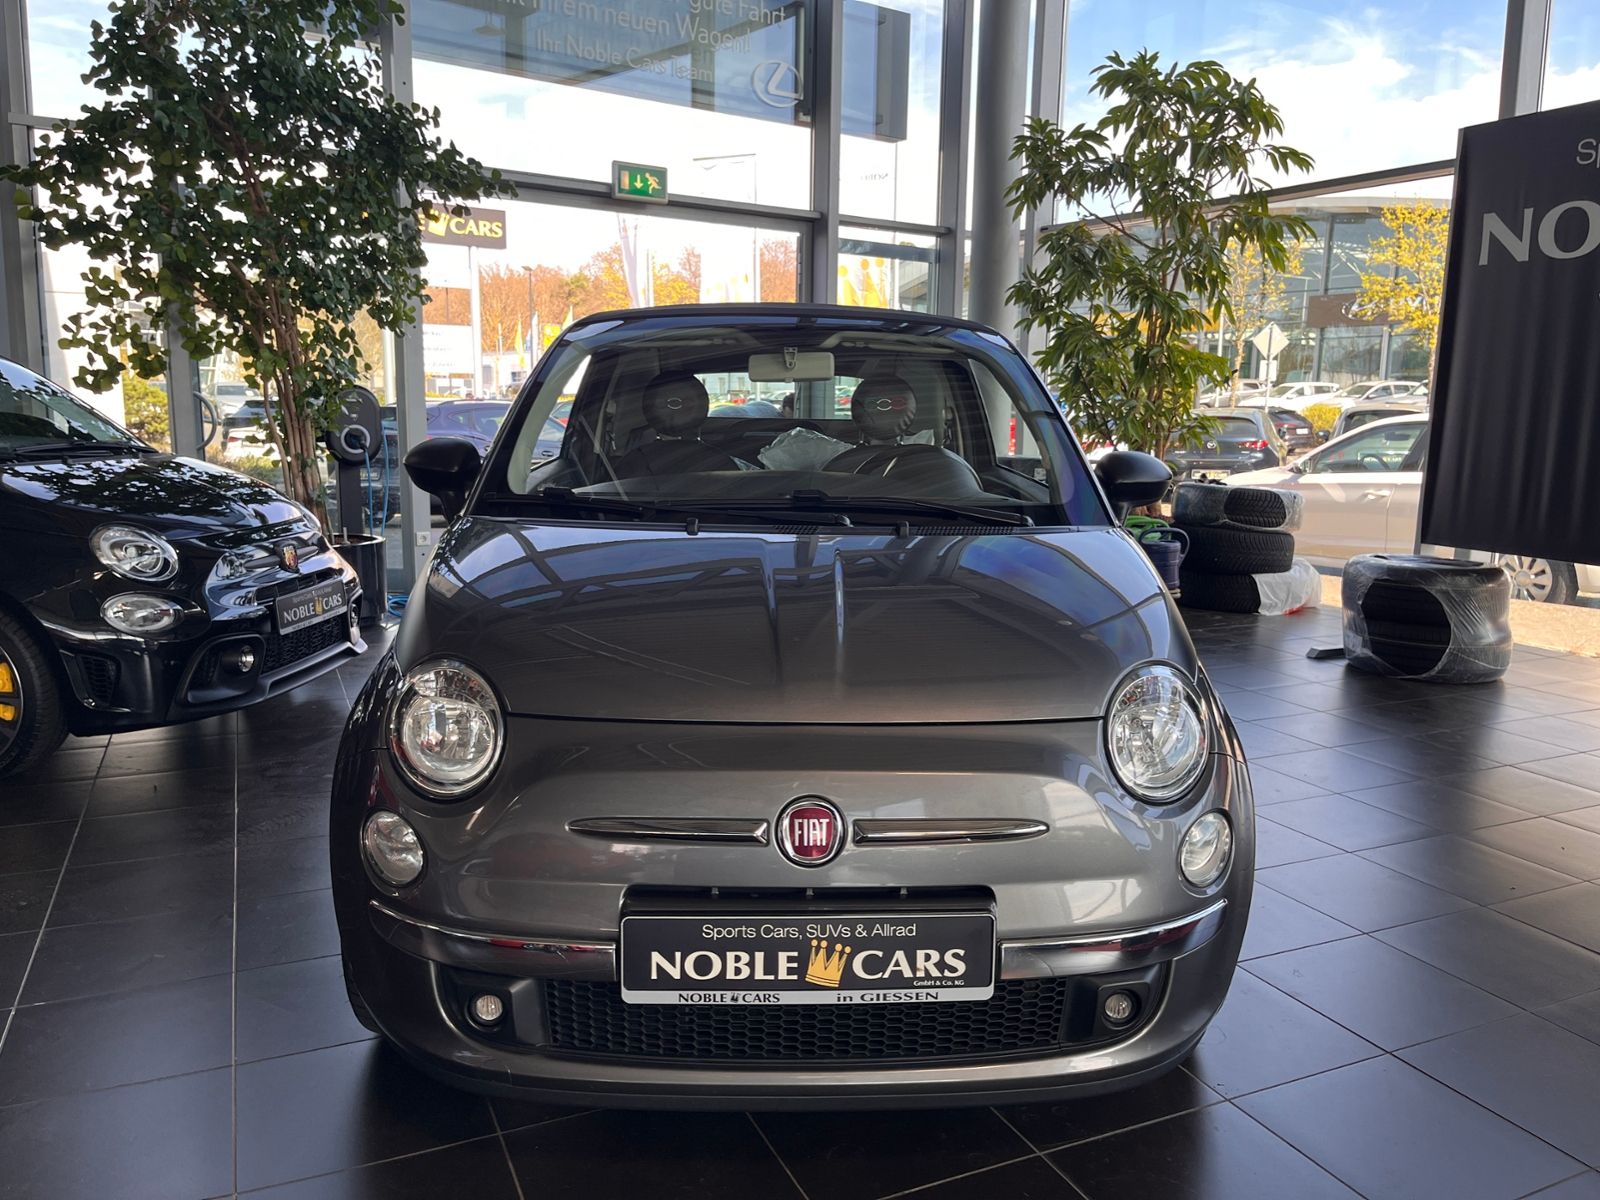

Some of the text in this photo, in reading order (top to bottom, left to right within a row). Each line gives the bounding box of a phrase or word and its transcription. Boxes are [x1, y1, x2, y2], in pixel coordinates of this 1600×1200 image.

[604, 7, 670, 36] neuen
[535, 28, 713, 82] Ihr Noble Cars Team
[1576, 138, 1600, 168] S
[449, 217, 503, 238] CARS
[283, 602, 315, 624] NOBLE
[322, 593, 342, 610] CARS
[794, 818, 829, 847] FIAT
[702, 923, 916, 940] Sports Cars, SUVs & Allrad
[650, 948, 967, 981] NOBLE CARS
[678, 991, 940, 1003] NOBLE CARS in GIESSEN
